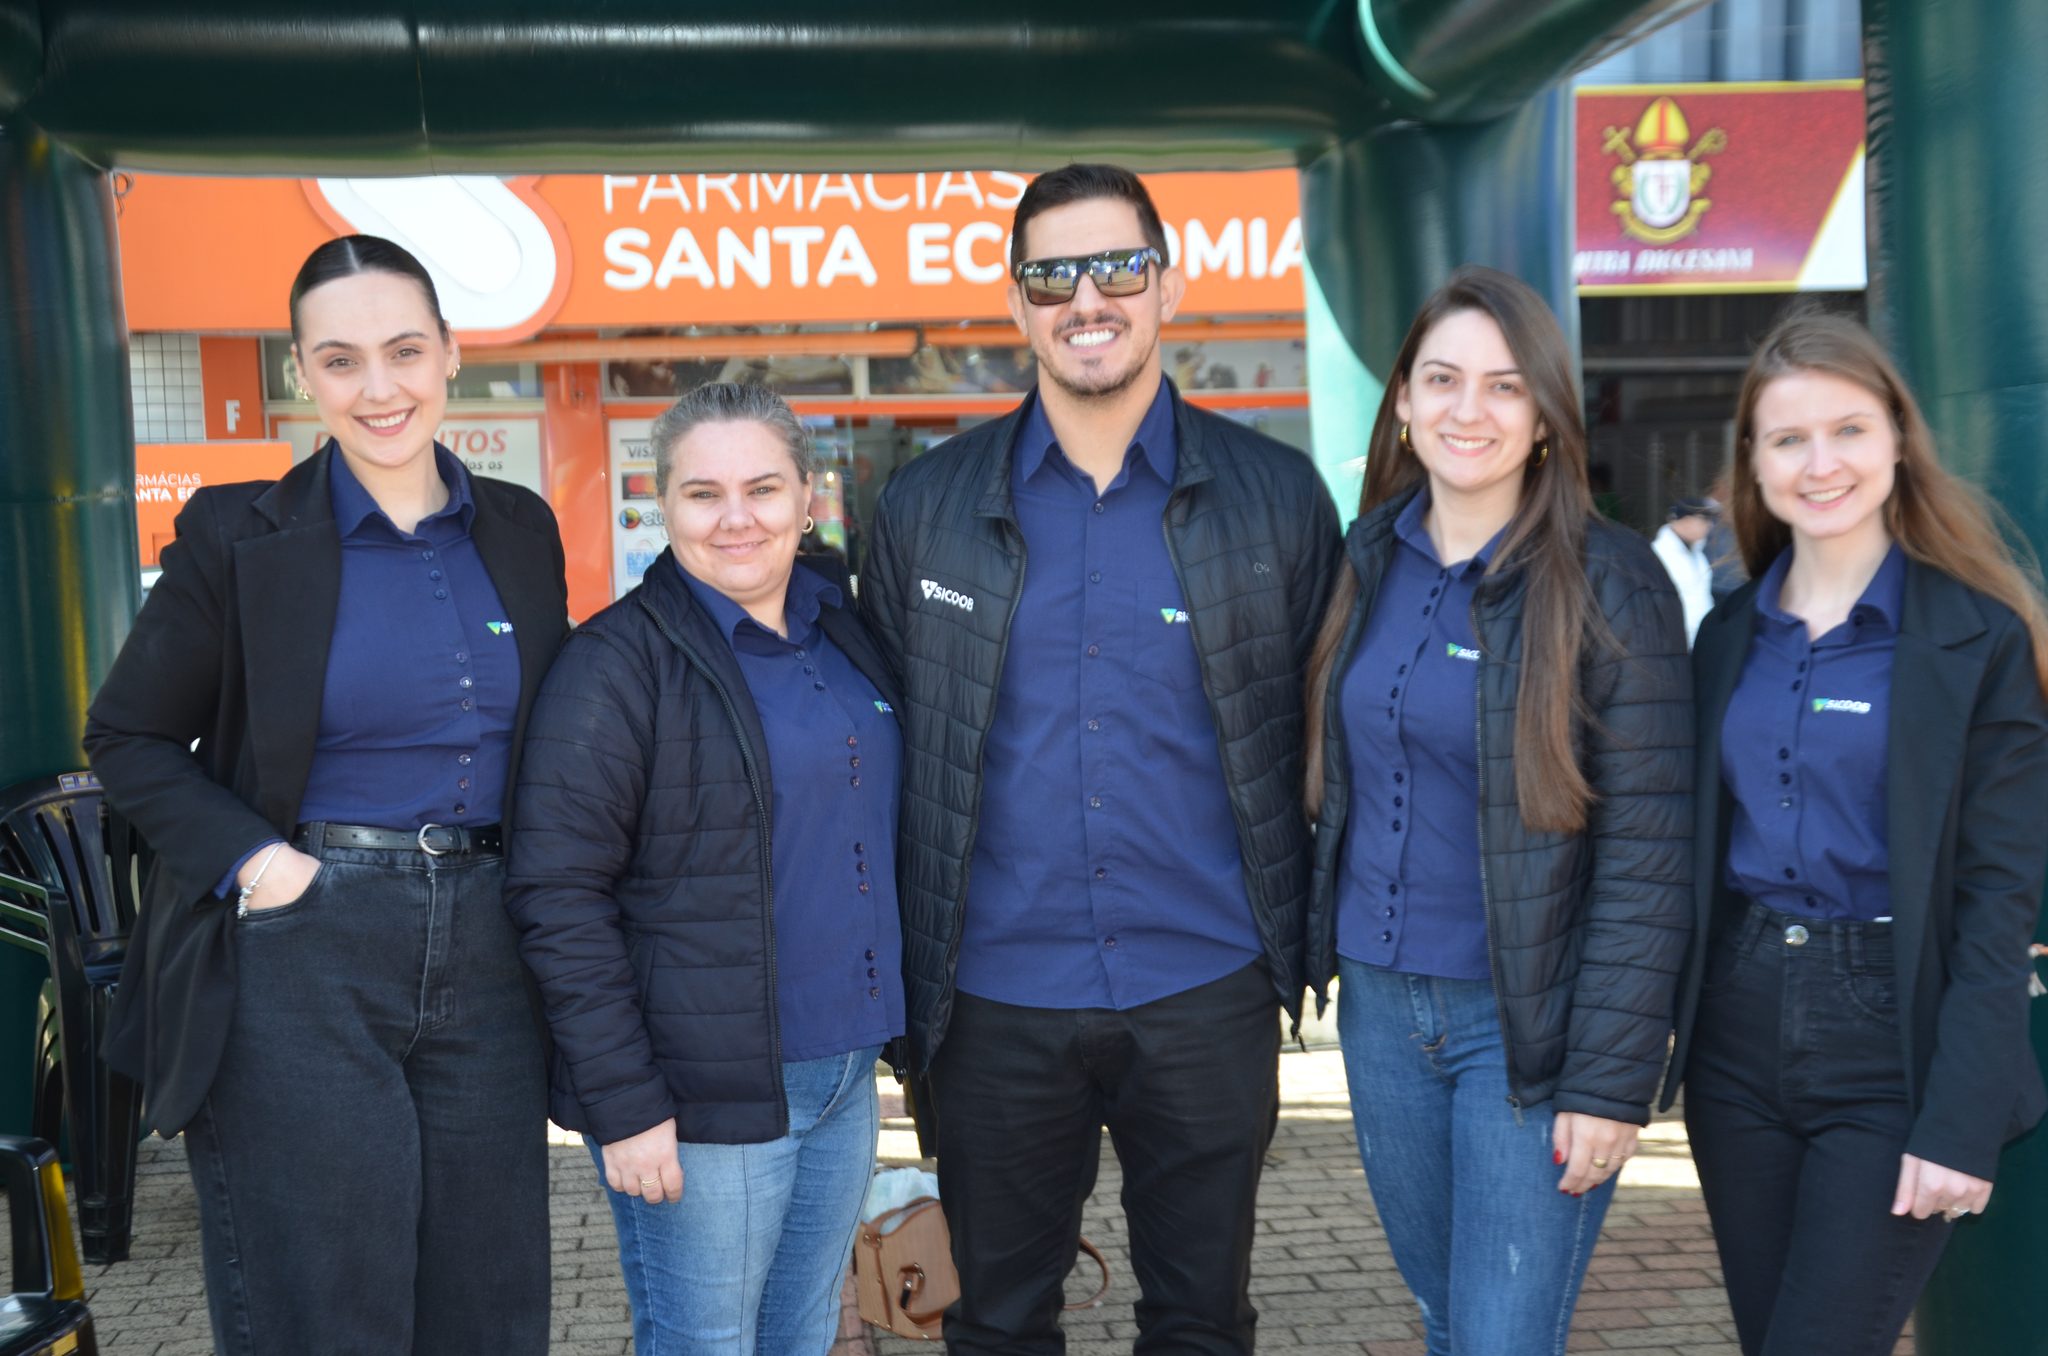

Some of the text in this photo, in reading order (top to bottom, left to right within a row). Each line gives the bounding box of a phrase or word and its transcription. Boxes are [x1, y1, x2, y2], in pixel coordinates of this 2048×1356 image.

[603, 226, 878, 290] SANTA
[135, 470, 202, 486] RMÁCIAS
[933, 586, 975, 612] SICOOB
